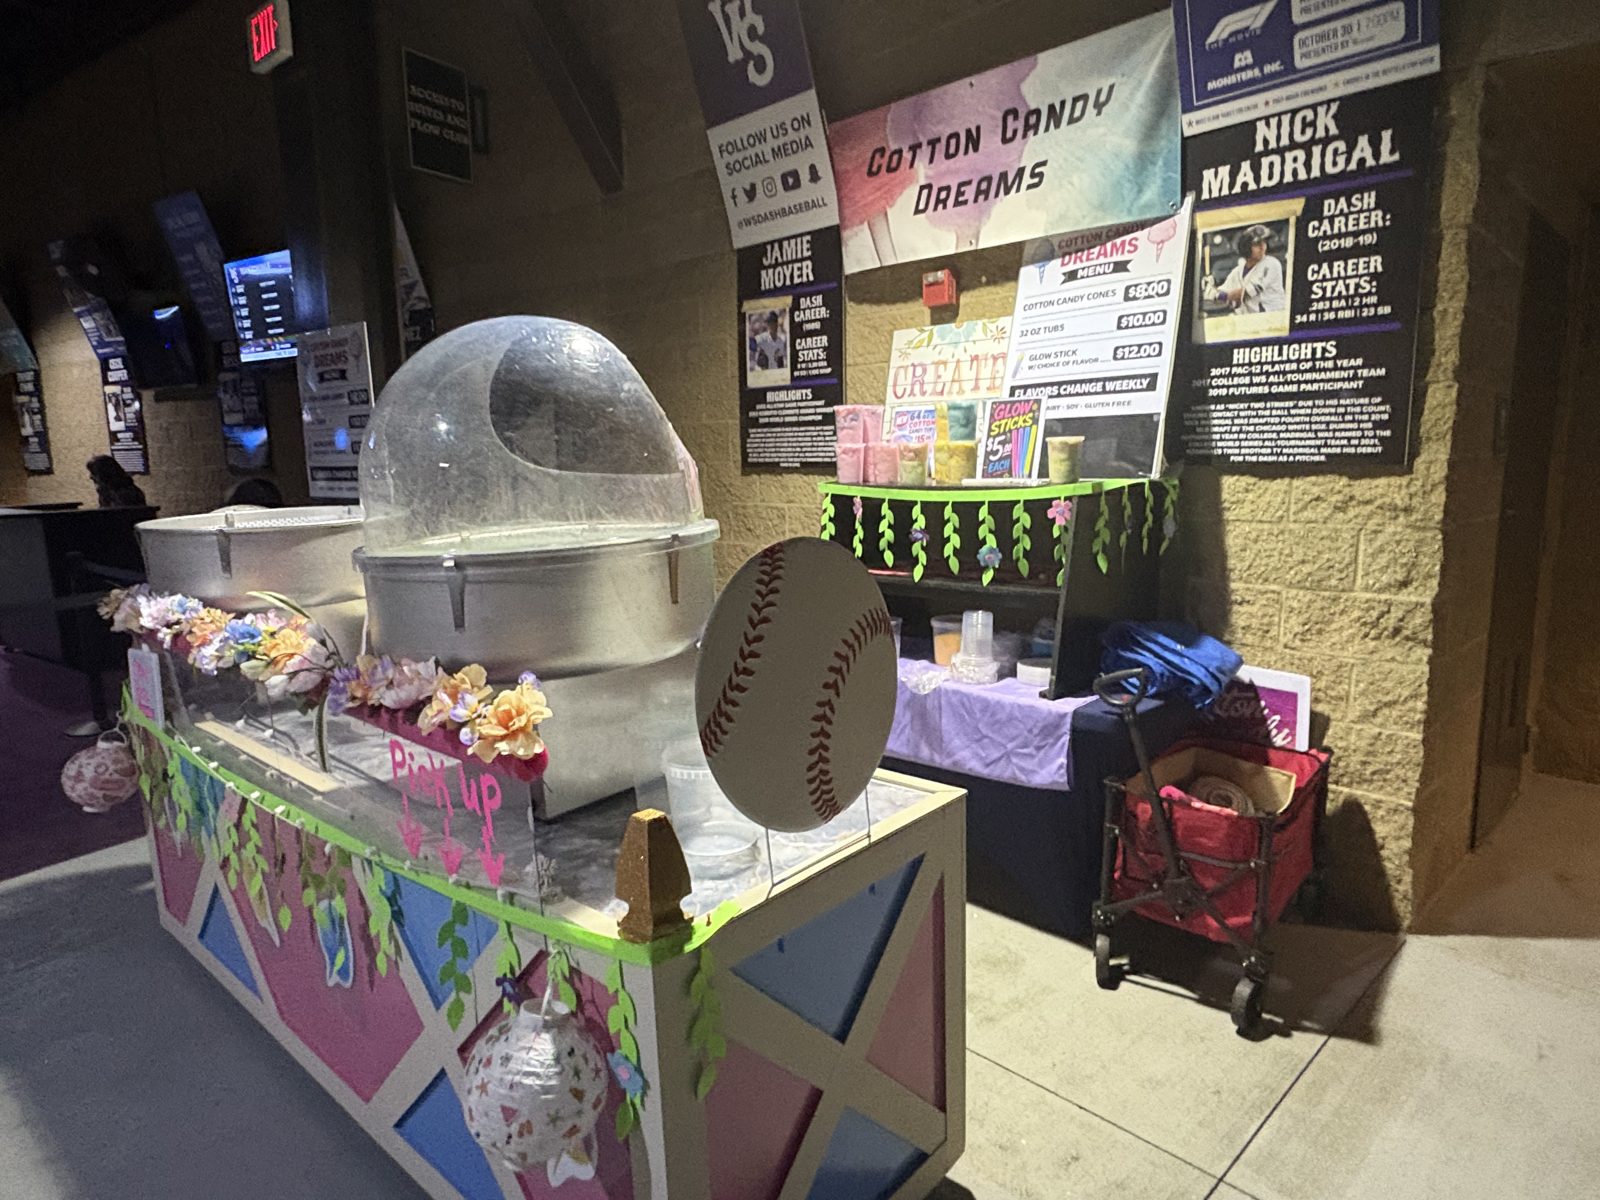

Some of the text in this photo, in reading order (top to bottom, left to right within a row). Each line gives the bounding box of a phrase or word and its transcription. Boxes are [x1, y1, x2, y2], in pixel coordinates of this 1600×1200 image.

[251, 4, 274, 62] EXIT
[1298, 27, 1338, 50] OCTOBER
[718, 112, 812, 159] FOLLOW US ON
[866, 82, 1116, 178] COTTON CANDY
[1255, 101, 1340, 152] NICK
[725, 135, 814, 176] SOCIAL MEDIA
[1202, 128, 1400, 199] MADRIGAL
[912, 160, 1049, 216] DREAMS
[738, 197, 828, 229] @WSDASHBASEBALL
[1323, 191, 1376, 217] DASH
[1308, 210, 1391, 238] CAREER:
[762, 234, 812, 267] JAMIE
[1060, 237, 1139, 268] DREAMS
[1318, 232, 1377, 253] (2018-19)
[760, 259, 814, 291] MOYER
[1077, 263, 1114, 279] MENU
[1307, 255, 1384, 281] CAREER
[1128, 281, 1168, 300] $8.00
[1311, 276, 1377, 299] STATS:
[800, 294, 823, 309] DASH
[1023, 289, 1117, 312] COTTON CANDY CONES
[794, 307, 830, 322] CAREER:
[1120, 311, 1164, 329] $10.00
[1019, 324, 1065, 338] 32 OZ TUBS
[795, 335, 828, 350] CAREER
[1116, 343, 1160, 359] $12.00
[1232, 341, 1337, 365] HIGHLIGHTS
[798, 348, 827, 362] STATS:
[1029, 349, 1078, 362] GLOW STICK
[1072, 358, 1099, 366] FLAVOR
[892, 352, 1007, 400] CREATE
[1210, 367, 1230, 376] 2017
[1262, 361, 1297, 373] PLAYER
[1299, 361, 1313, 370] OF
[1315, 359, 1335, 369] THE
[1336, 357, 1363, 367] YEAR
[1212, 376, 1251, 386] COLLEGE
[1252, 374, 1267, 384] WS
[1357, 368, 1386, 377] TEAM
[766, 388, 812, 403] HIGHLIGHTS
[1015, 377, 1151, 399] FLAVORS CHANGE WEEKLY
[1229, 385, 1269, 396] FUTURES
[1271, 383, 1299, 393] GAME
[1300, 380, 1364, 391] PARTICIPANT
[994, 400, 1033, 419] GLOW
[1326, 398, 1338, 406] HIS
[1347, 405, 1361, 413] THE
[990, 413, 1033, 436] STICKS
[1376, 429, 1391, 437] THE
[988, 459, 1010, 473] EACH
